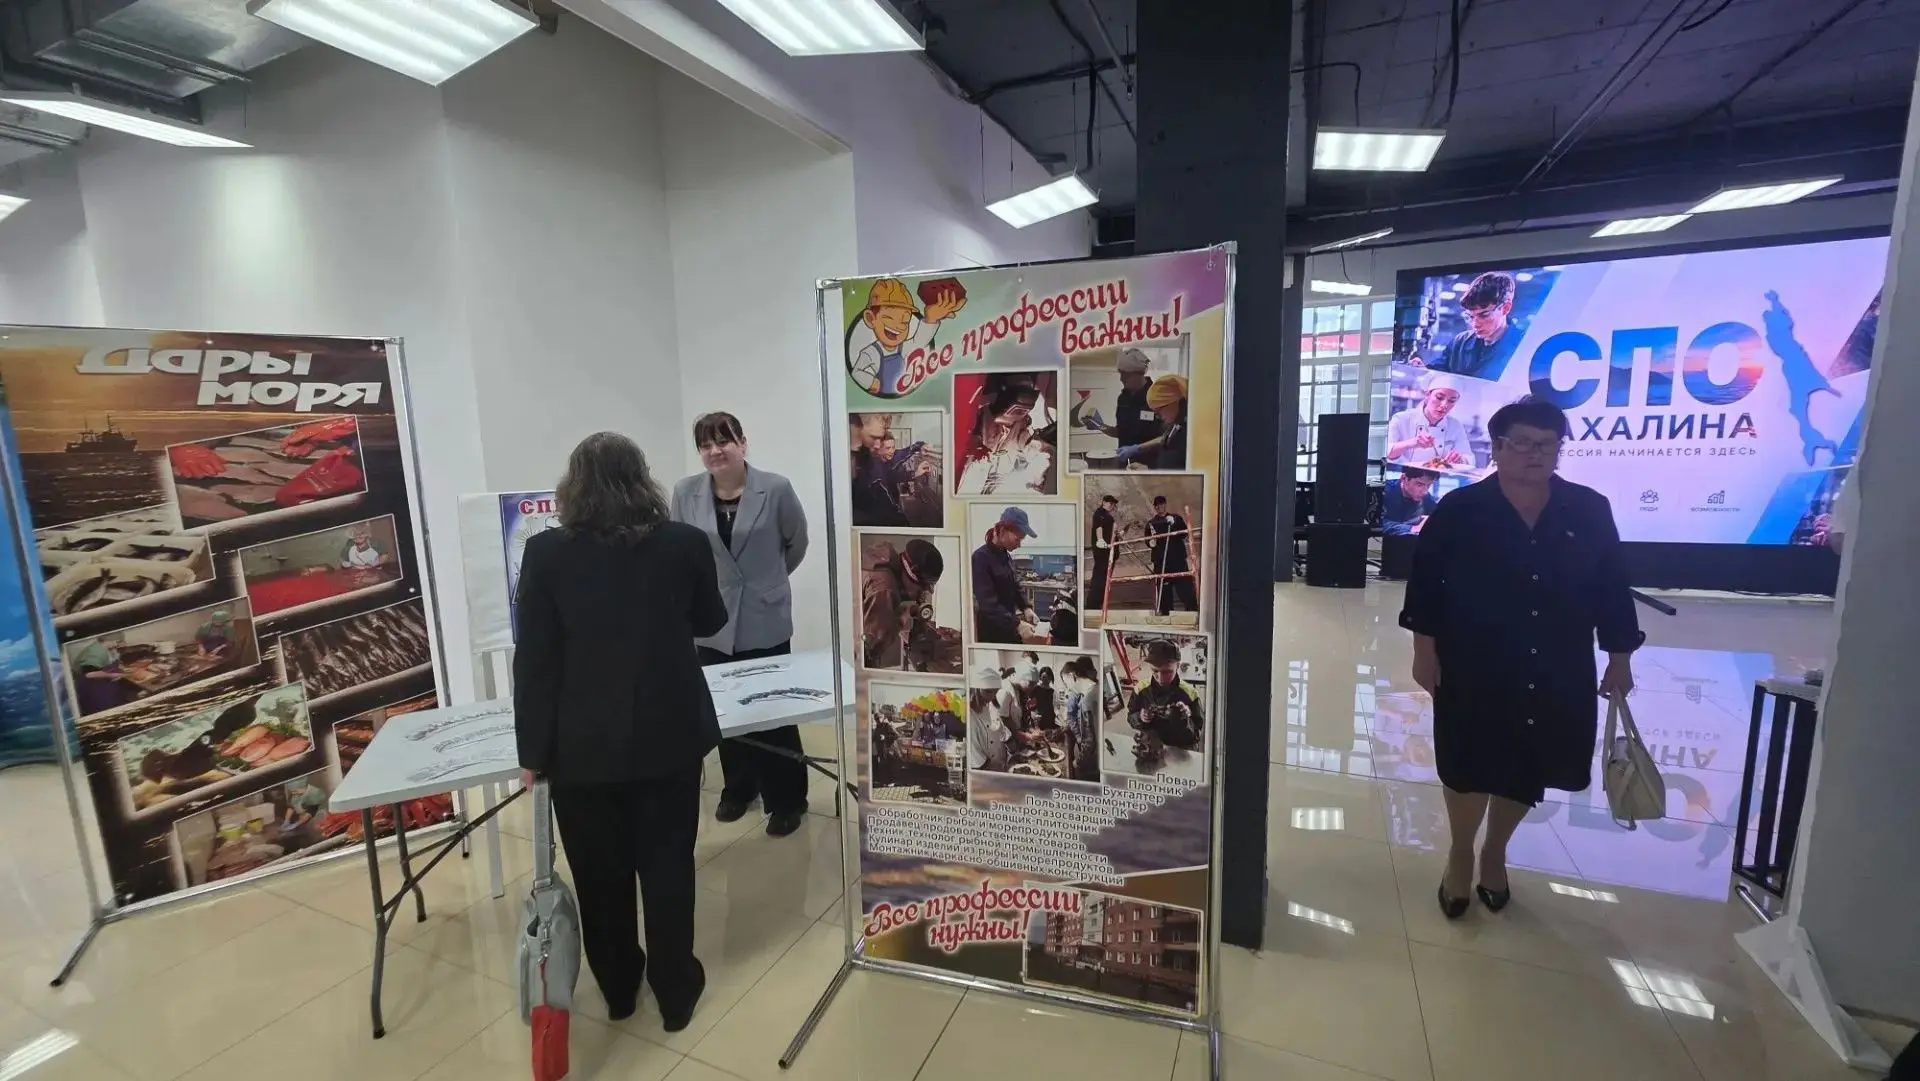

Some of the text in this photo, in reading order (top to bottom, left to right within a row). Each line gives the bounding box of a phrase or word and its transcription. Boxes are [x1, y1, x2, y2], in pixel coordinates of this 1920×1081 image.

[897, 279, 1129, 393] Все профессии
[1060, 295, 1183, 353] важны!
[75, 348, 312, 381] Дары
[1528, 321, 1764, 410] СПО
[197, 381, 381, 411] моря
[1562, 411, 1757, 441] АХАЛИНА
[1559, 446, 1757, 458] ЕССИЯ НАЧИНАЕТСЯ ЗДЕСЬ
[519, 499, 556, 514] СП
[1103, 786, 1164, 804] Бухгалтер
[1128, 780, 1182, 796] Плотник
[1157, 773, 1196, 788] Повар
[991, 802, 1115, 826] Электрогазосварщик
[1026, 796, 1128, 818] Пользователь ПК
[1054, 790, 1148, 811] Электромонтер
[868, 816, 1086, 851] Продавец продовольственных товаров
[878, 808, 943, 822] Обработчик
[946, 816, 975, 827] рыбы
[989, 822, 1079, 842] морепродуктов
[960, 807, 1099, 834] Облицовщик-плиточник
[869, 825, 1108, 864] Техник технолог рыбной промышленности
[869, 843, 929, 855] Монтажник
[869, 834, 913, 847] Кулинар
[978, 848, 1009, 858] рыбы
[1022, 854, 1113, 875] морепродуктов
[864, 879, 1081, 937] Все профессии
[930, 910, 1028, 950] нужны!
